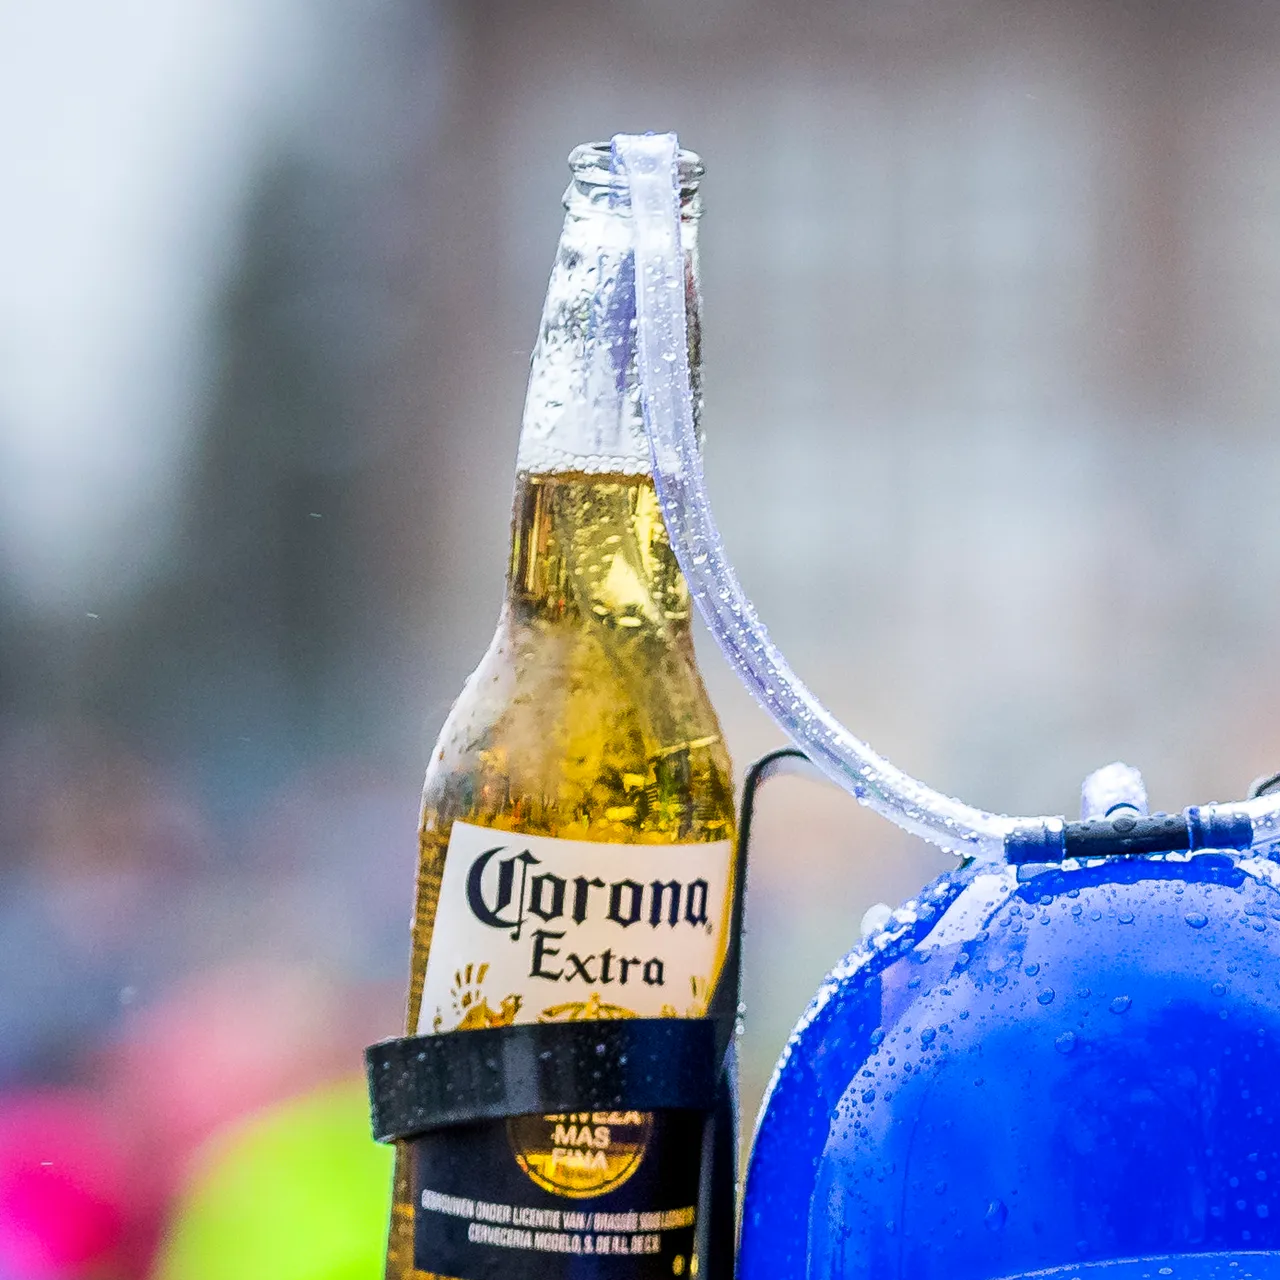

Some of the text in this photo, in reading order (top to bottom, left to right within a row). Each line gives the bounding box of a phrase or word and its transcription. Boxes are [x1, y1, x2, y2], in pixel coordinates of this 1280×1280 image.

[466, 846, 709, 941] Corona
[529, 928, 665, 986] Extra
[553, 1123, 611, 1149] MAS
[551, 1147, 608, 1171] FINA
